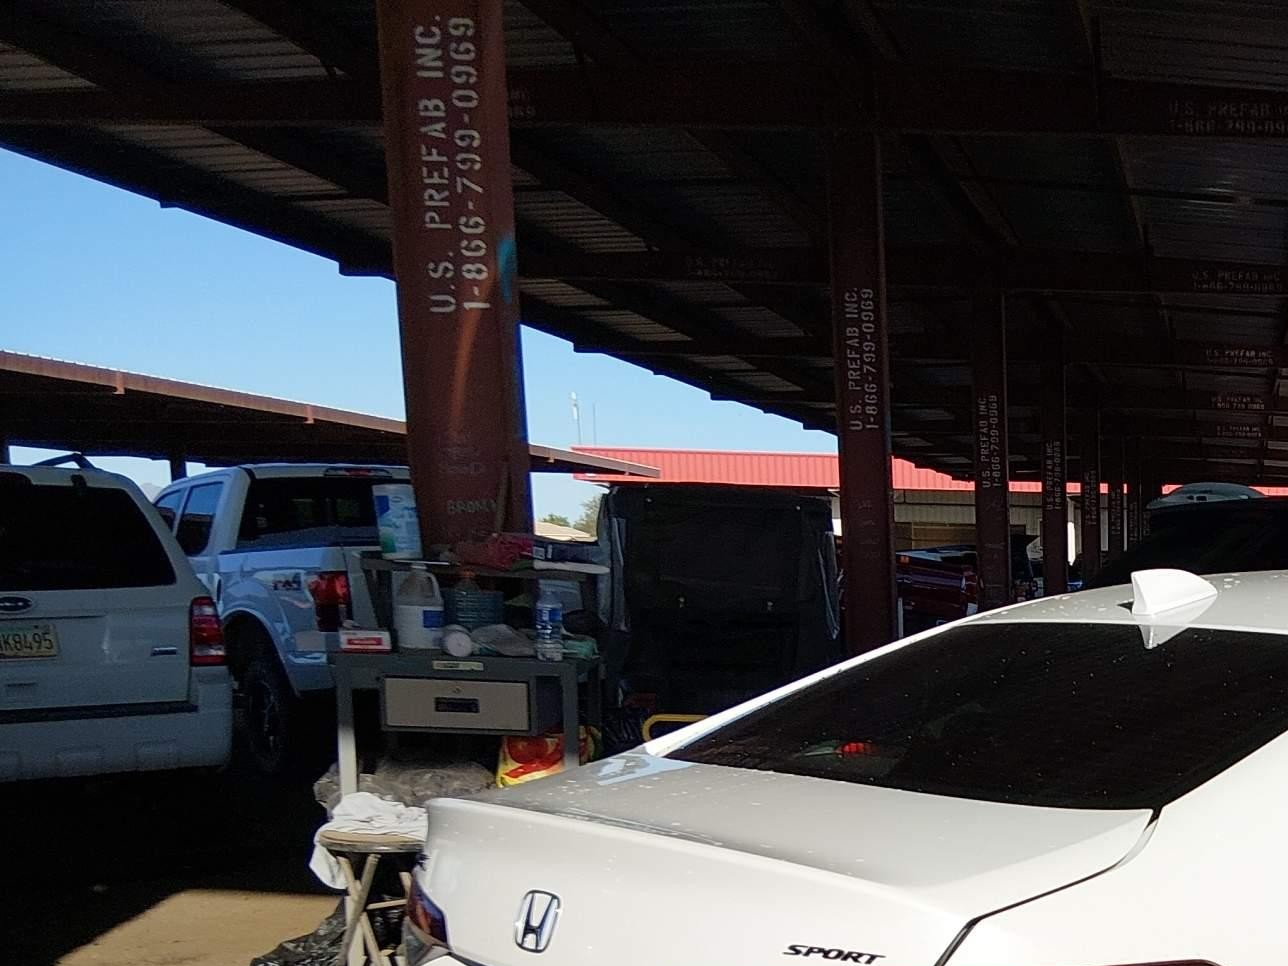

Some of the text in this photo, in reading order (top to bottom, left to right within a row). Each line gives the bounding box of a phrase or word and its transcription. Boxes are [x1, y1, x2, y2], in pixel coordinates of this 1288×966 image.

[414, 15, 457, 314] U.S. PREFAB INC.
[448, 17, 490, 311] 1-866-799-0969
[844, 287, 864, 432] U.S. PREFAB INC.
[860, 288, 880, 430] 1-866-799-0969
[0, 632, 54, 652] K8495
[782, 944, 887, 965] SPORT
